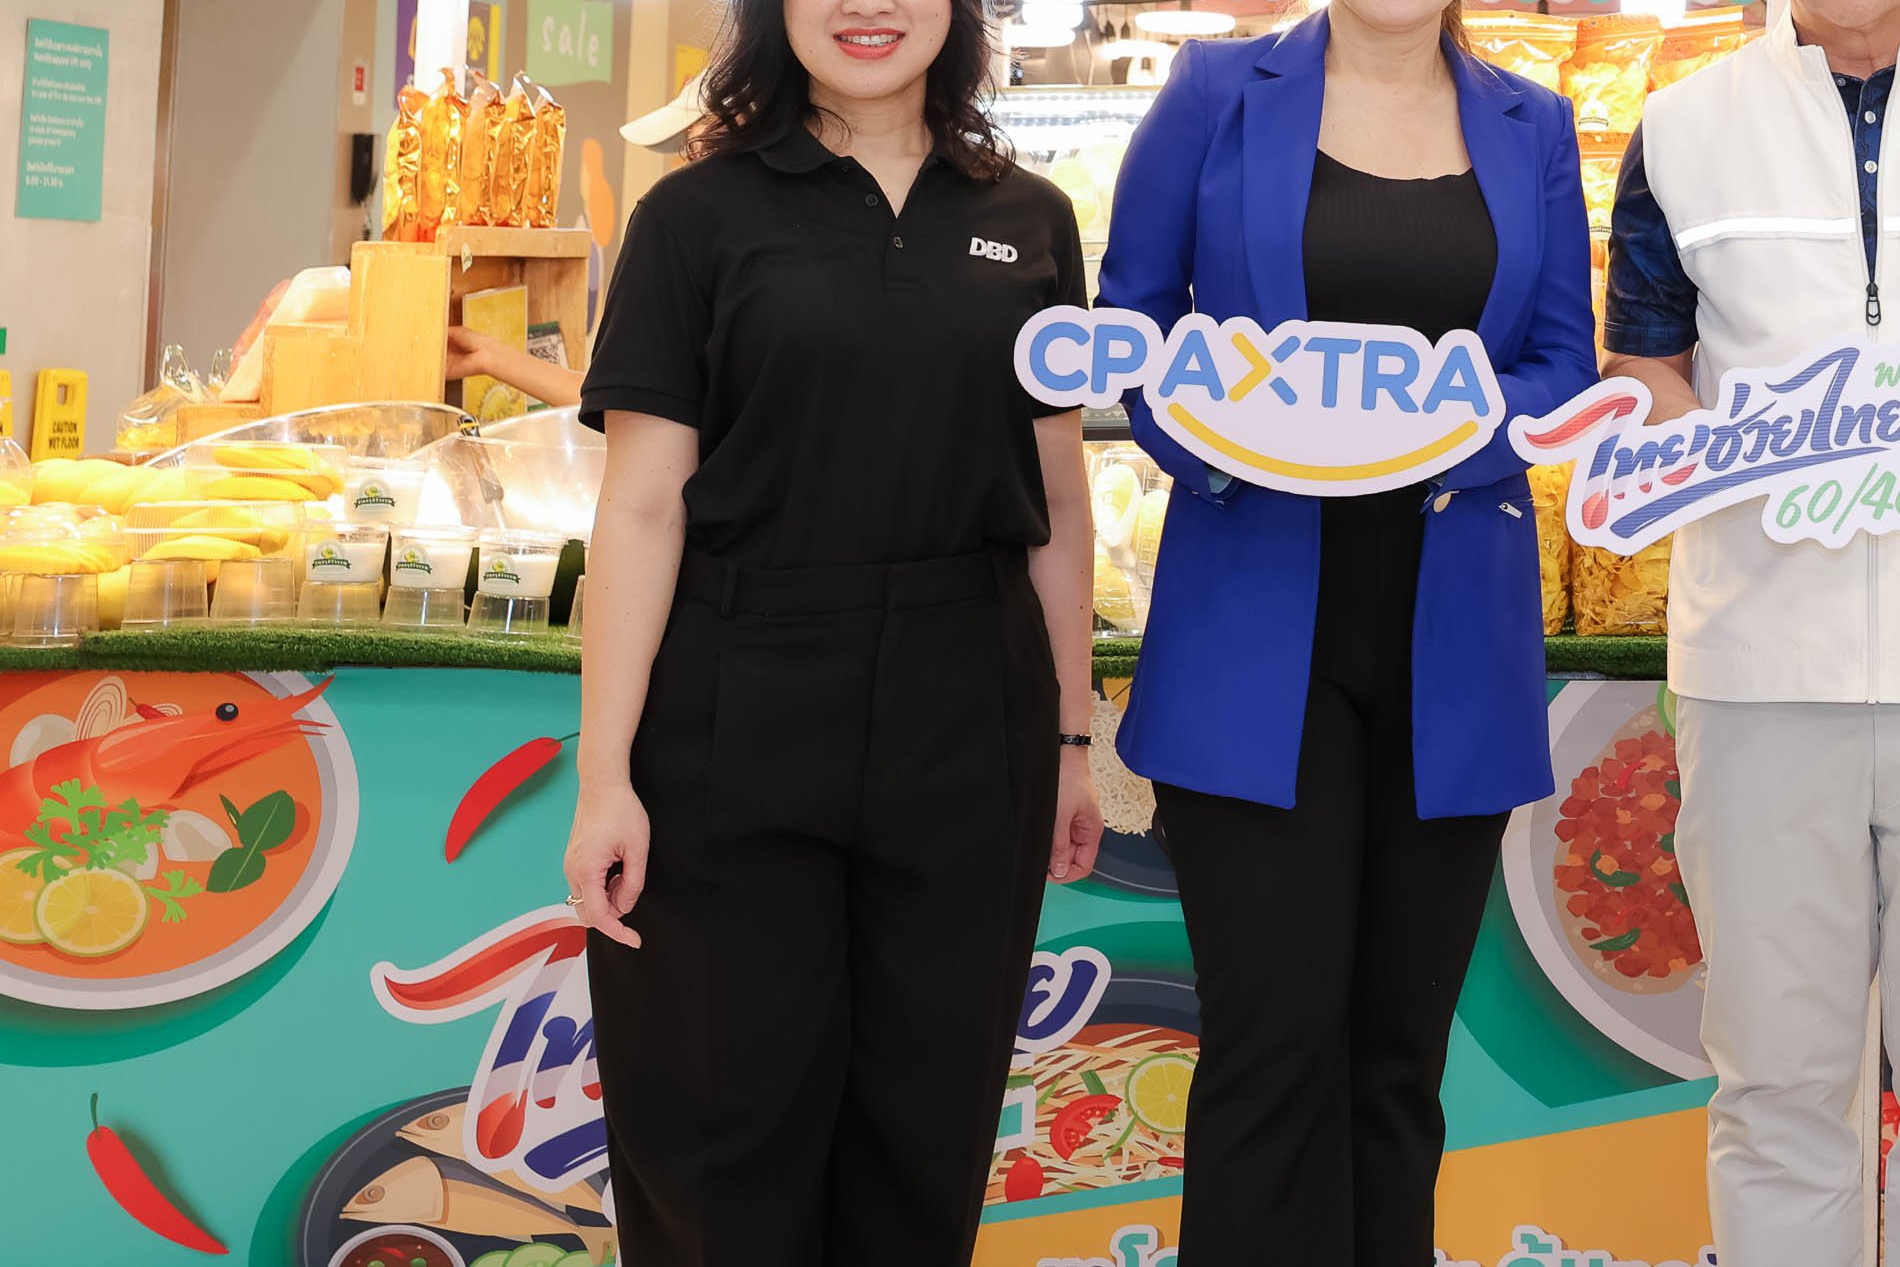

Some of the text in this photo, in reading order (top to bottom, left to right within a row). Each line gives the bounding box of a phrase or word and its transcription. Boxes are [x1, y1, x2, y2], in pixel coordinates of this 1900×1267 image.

[541, 8, 600, 67] sale
[969, 237, 1019, 264] DBD
[52, 421, 78, 434] CAUTION
[48, 436, 80, 450] WET FLOOR
